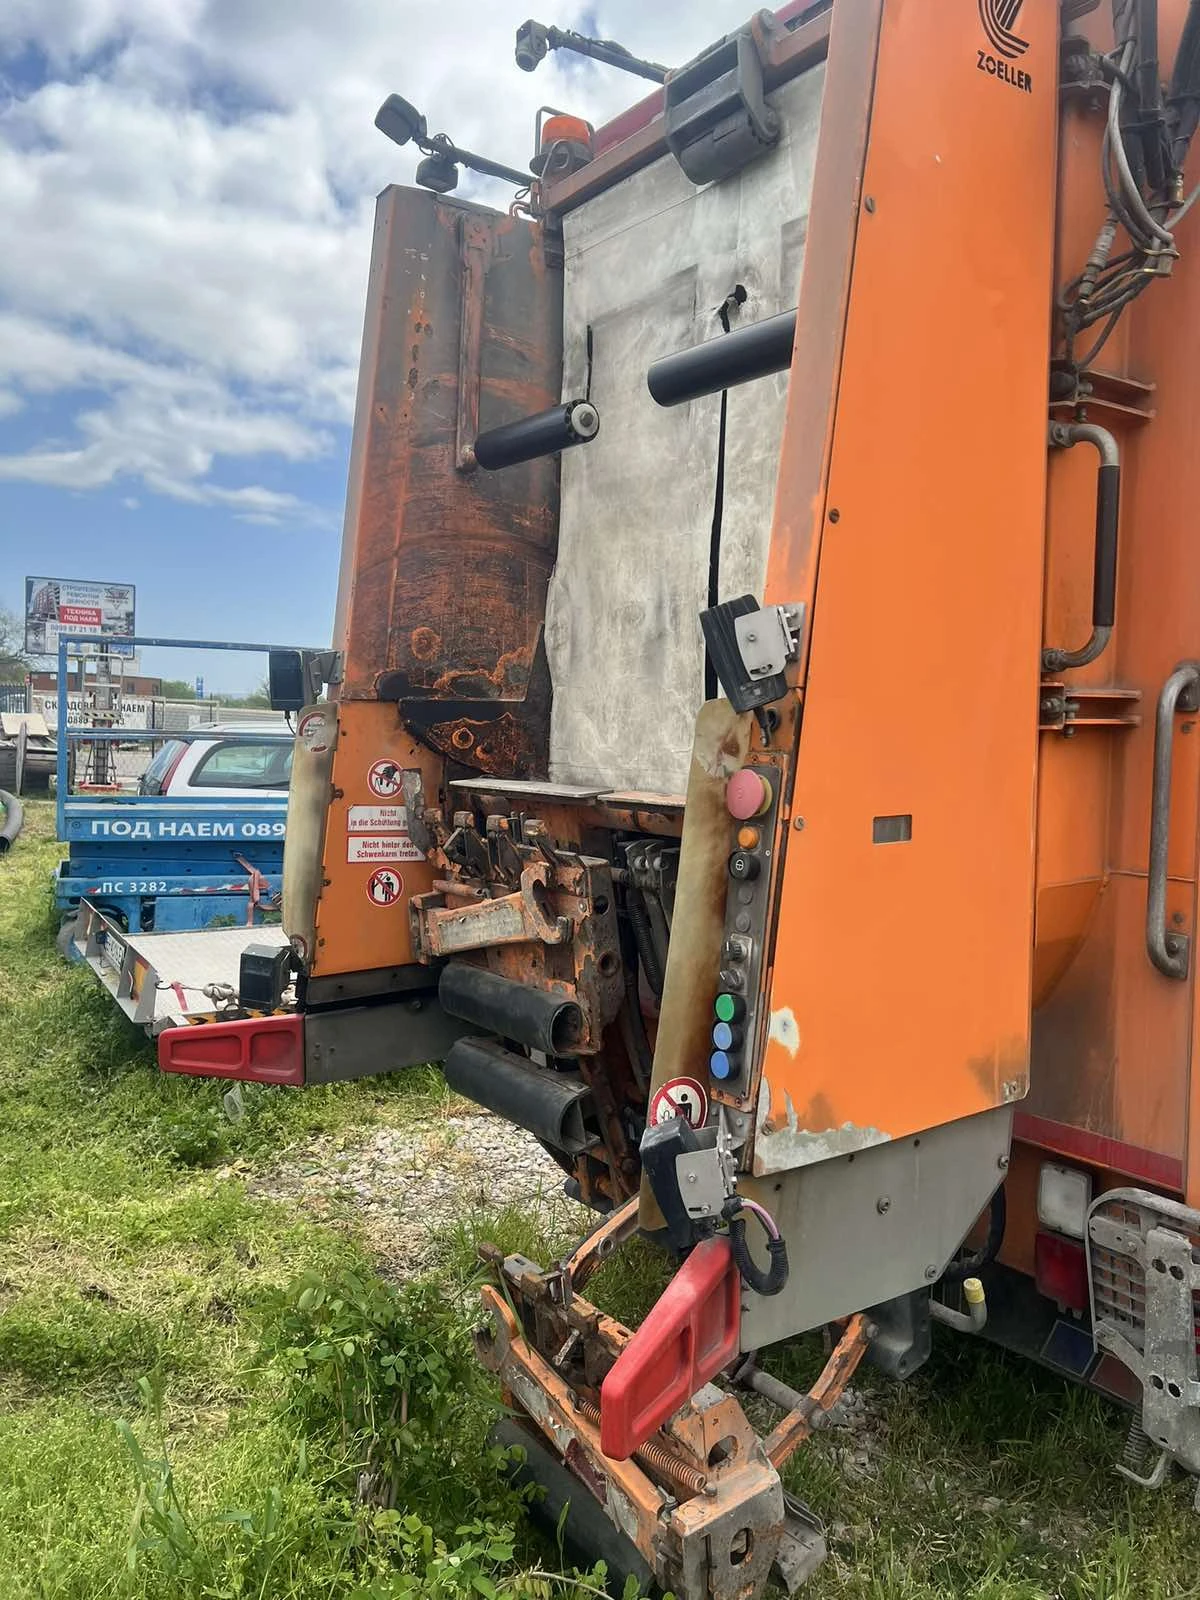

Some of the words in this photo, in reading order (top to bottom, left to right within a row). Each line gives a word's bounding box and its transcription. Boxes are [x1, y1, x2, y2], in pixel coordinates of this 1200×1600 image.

[977, 50, 1032, 94] ZOELLER
[80, 615, 98, 623] НАЕМ
[121, 704, 145, 713] НАЕМ
[91, 820, 151, 838] ПОД
[158, 822, 234, 837] НАЕМ
[362, 841, 379, 849] Nicht
[382, 841, 399, 849] hinter
[356, 850, 397, 858] Schwenkarm
[400, 850, 418, 858] treten
[102, 882, 123, 893] ПС
[129, 881, 168, 893] 3282
